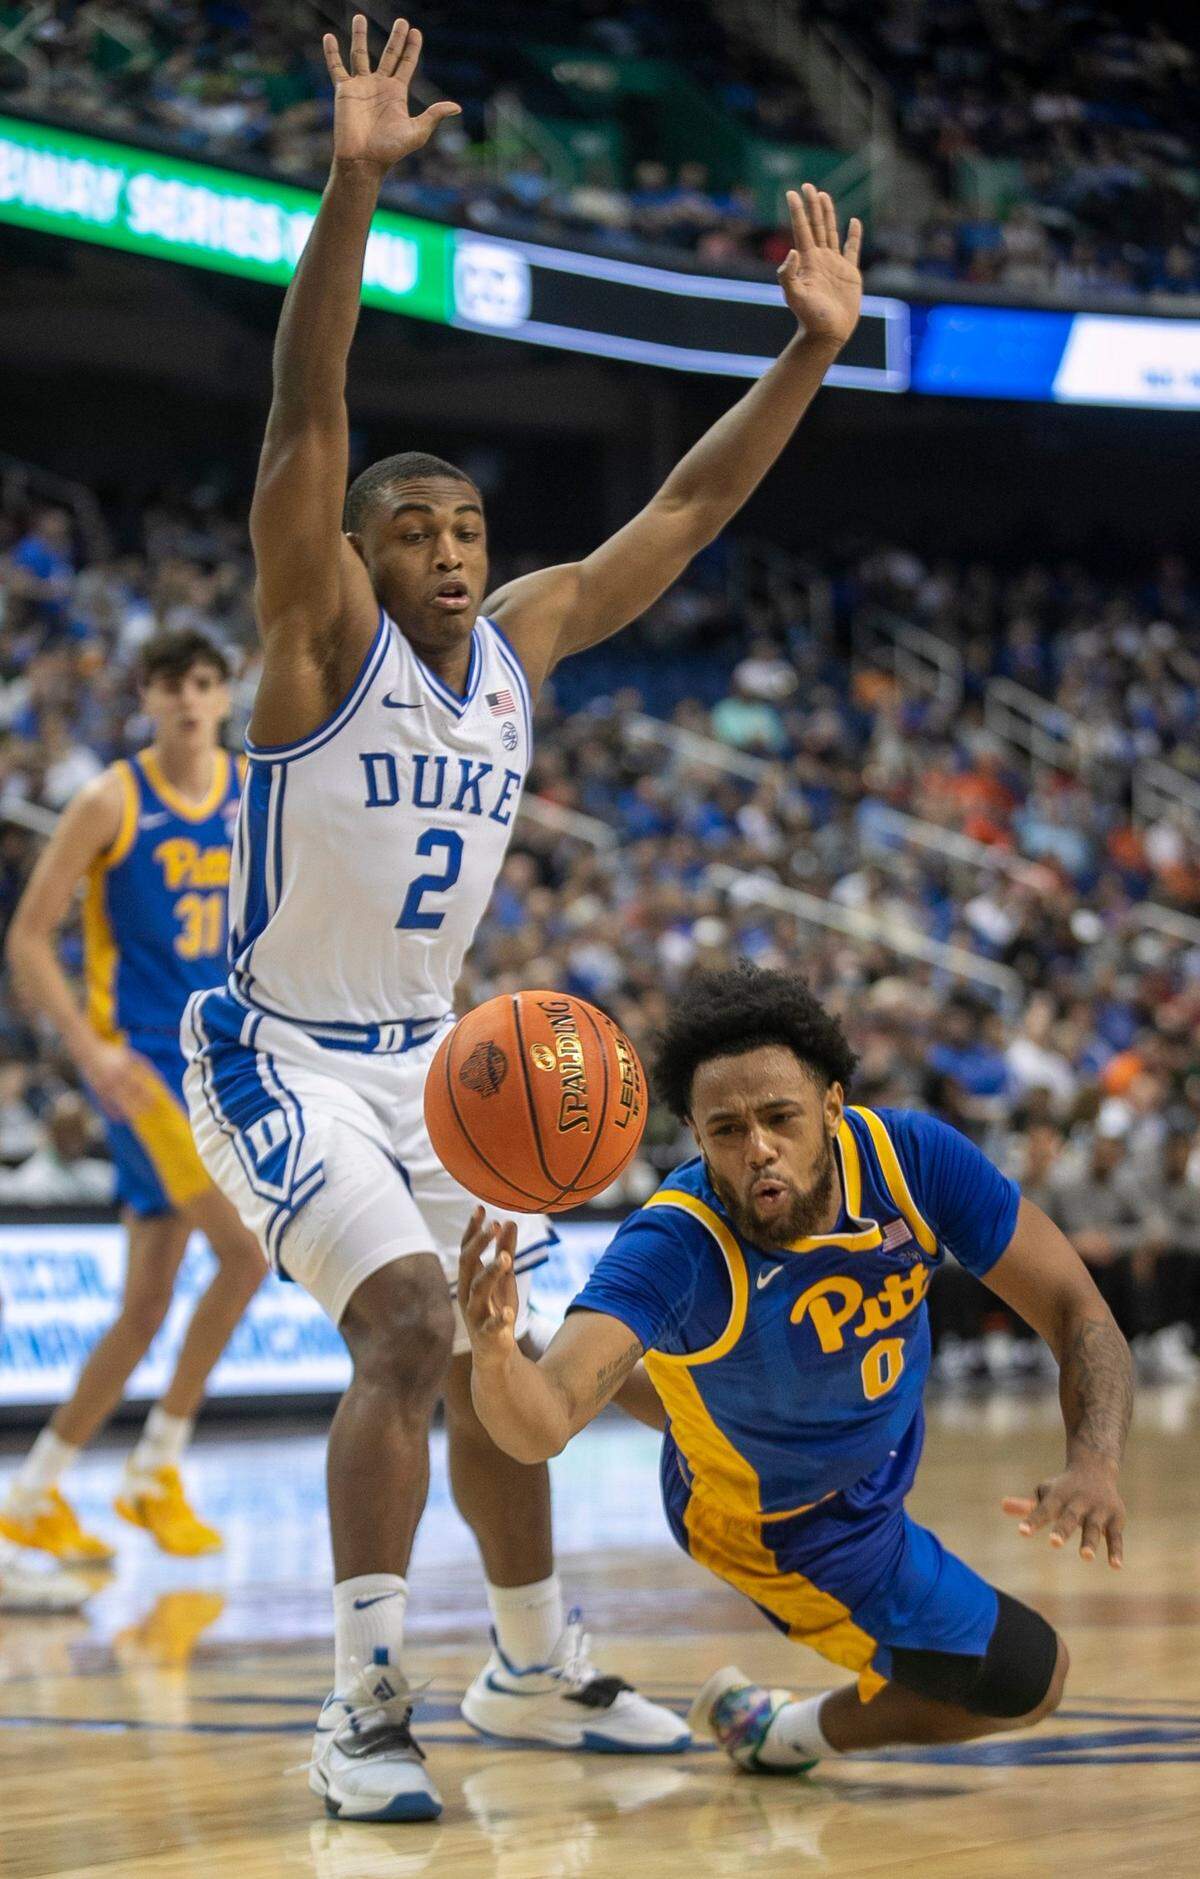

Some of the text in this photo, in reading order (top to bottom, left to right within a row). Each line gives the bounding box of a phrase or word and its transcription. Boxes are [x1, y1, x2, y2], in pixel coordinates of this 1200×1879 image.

[359, 752, 521, 826] DUKE
[395, 828, 464, 929] 2
[174, 891, 224, 960] 31
[536, 1000, 591, 1134] SPALDING
[789, 1262, 930, 1354] Pitt
[861, 1337, 905, 1401] 0
